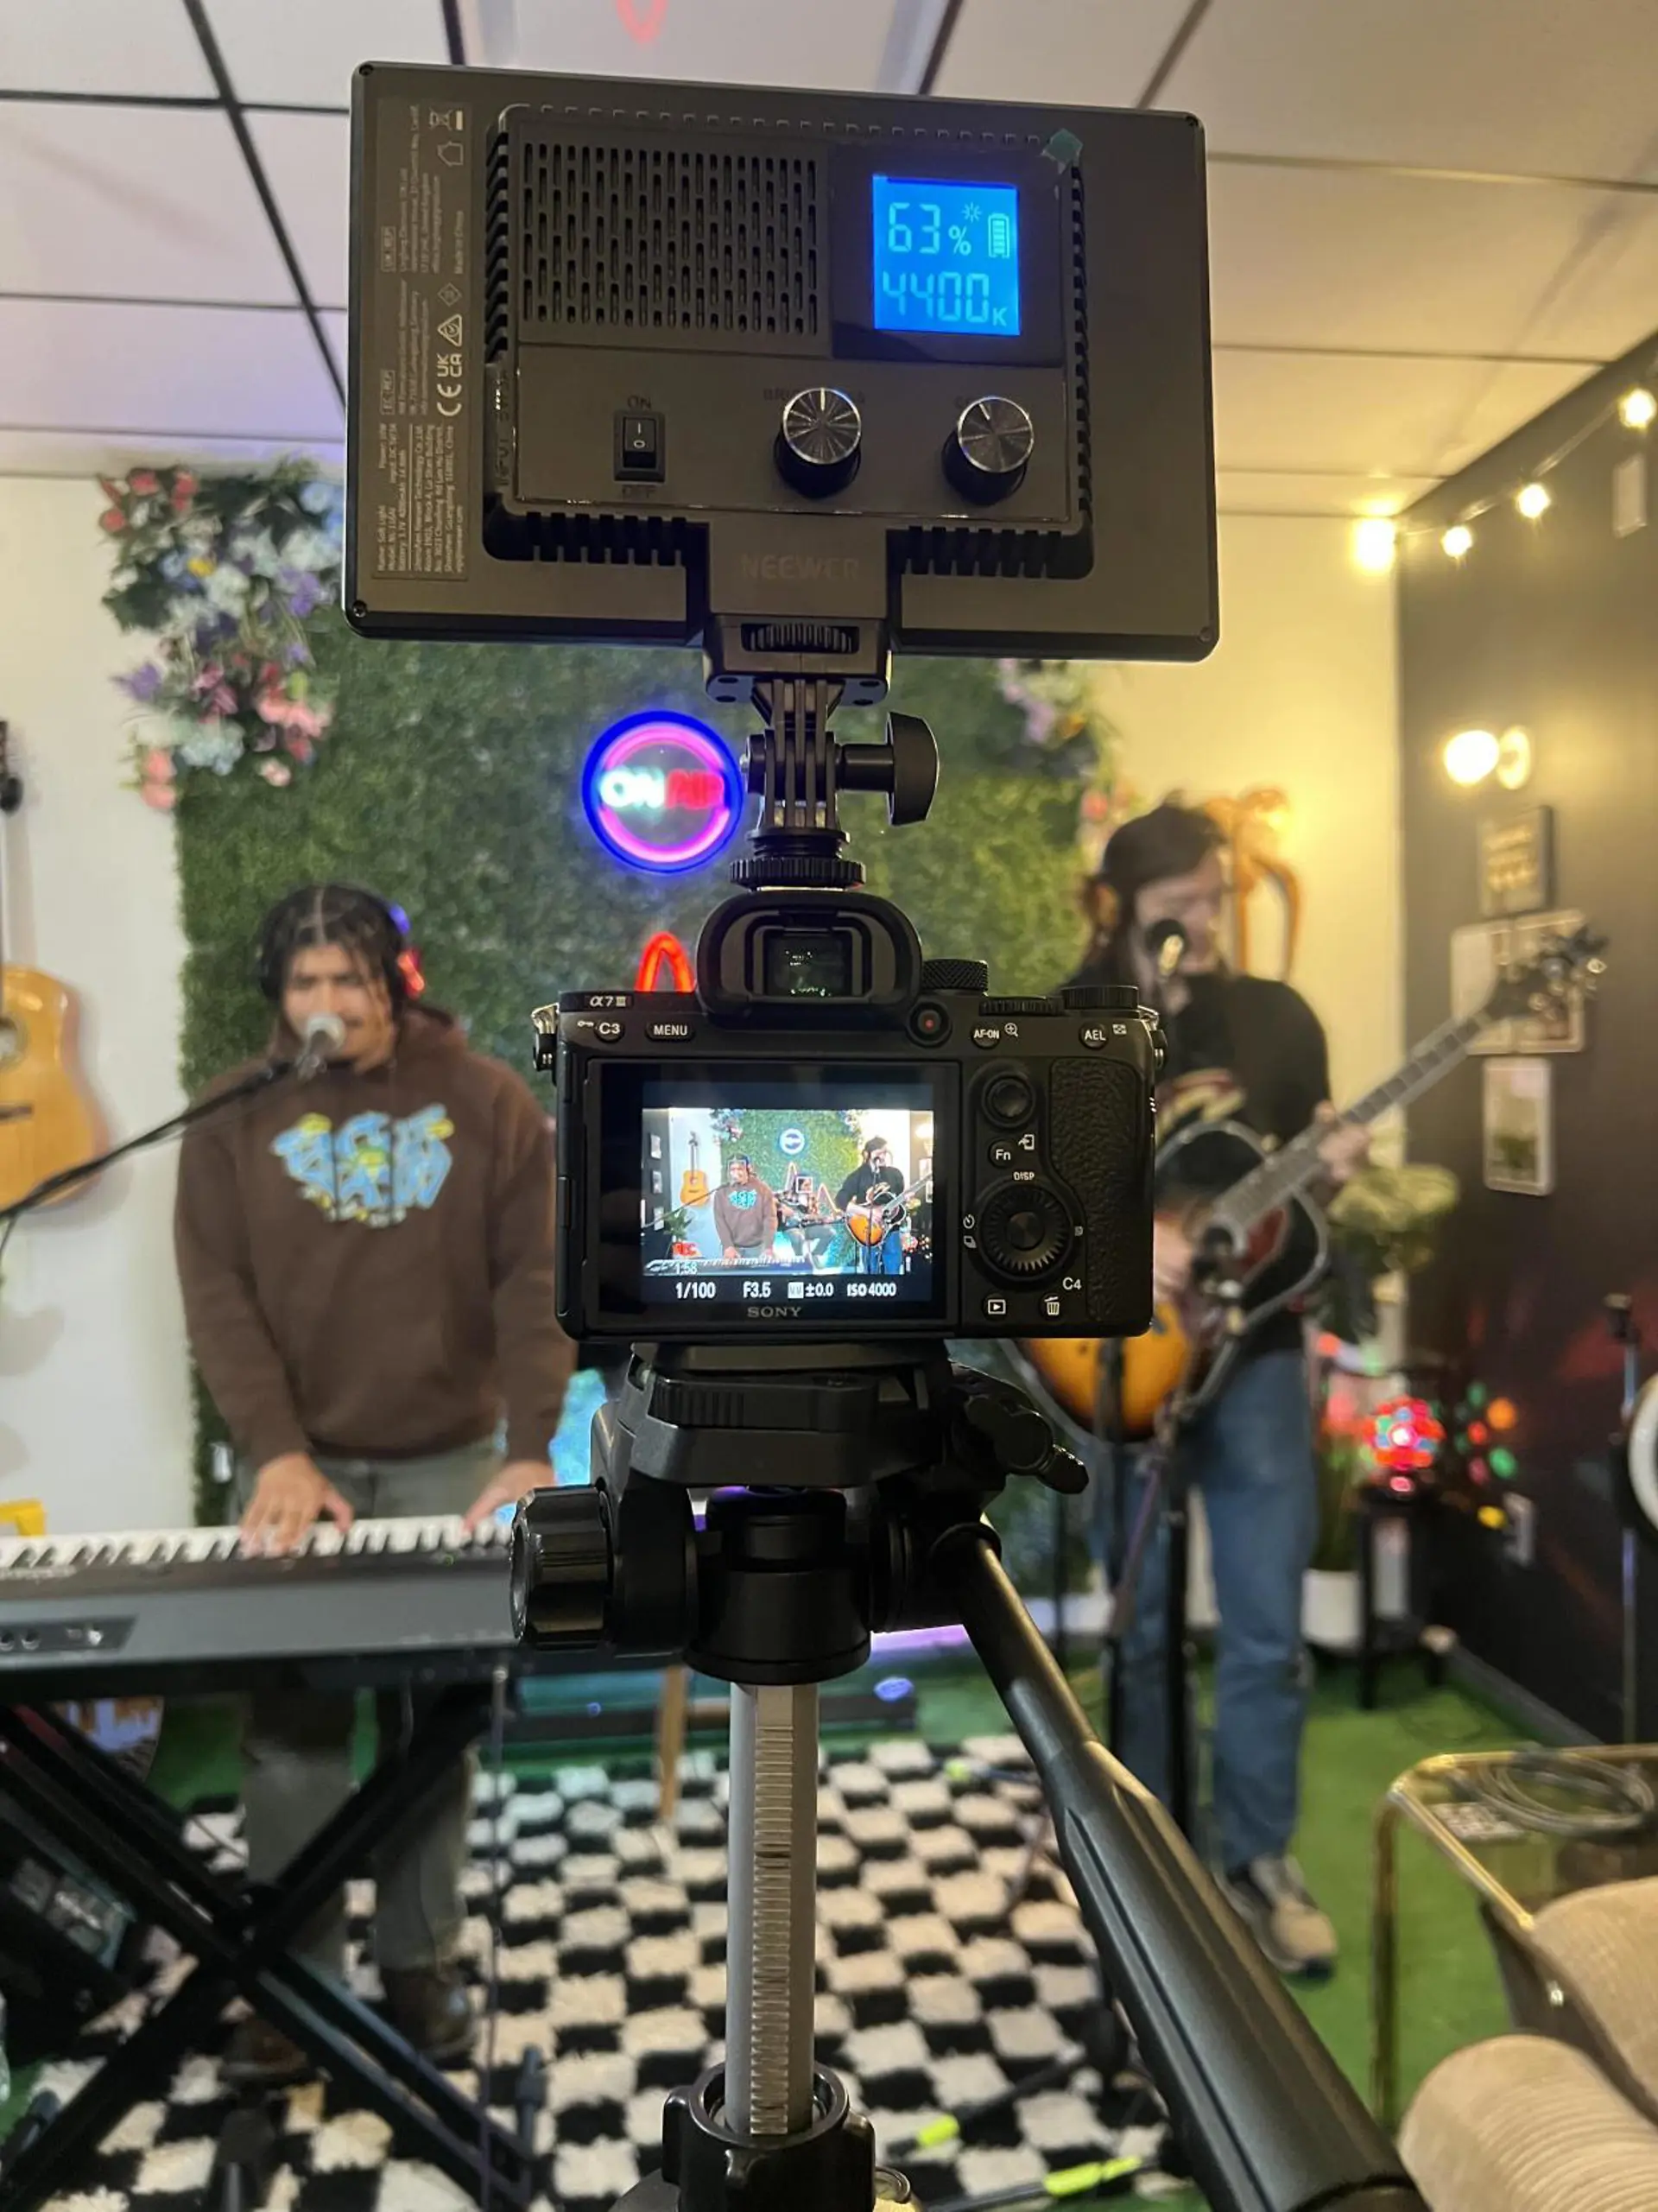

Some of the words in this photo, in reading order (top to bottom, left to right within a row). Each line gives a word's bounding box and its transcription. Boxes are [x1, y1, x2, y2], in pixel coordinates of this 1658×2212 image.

[437, 352, 449, 377] UK
[449, 353, 462, 377] CA
[628, 395, 652, 410] ON
[740, 553, 860, 581] NEEWER
[598, 1023, 620, 1035] C3
[654, 1024, 687, 1036] MENU
[973, 1029, 1000, 1039] AF-ON
[1085, 1030, 1106, 1041] AEL
[996, 1149, 1011, 1161] Fn
[1013, 1171, 1035, 1181] DISP
[1062, 1277, 1082, 1290] C4
[675, 1282, 717, 1299] 1/100
[868, 1282, 897, 1296] 4000
[747, 1306, 801, 1317] SONY
